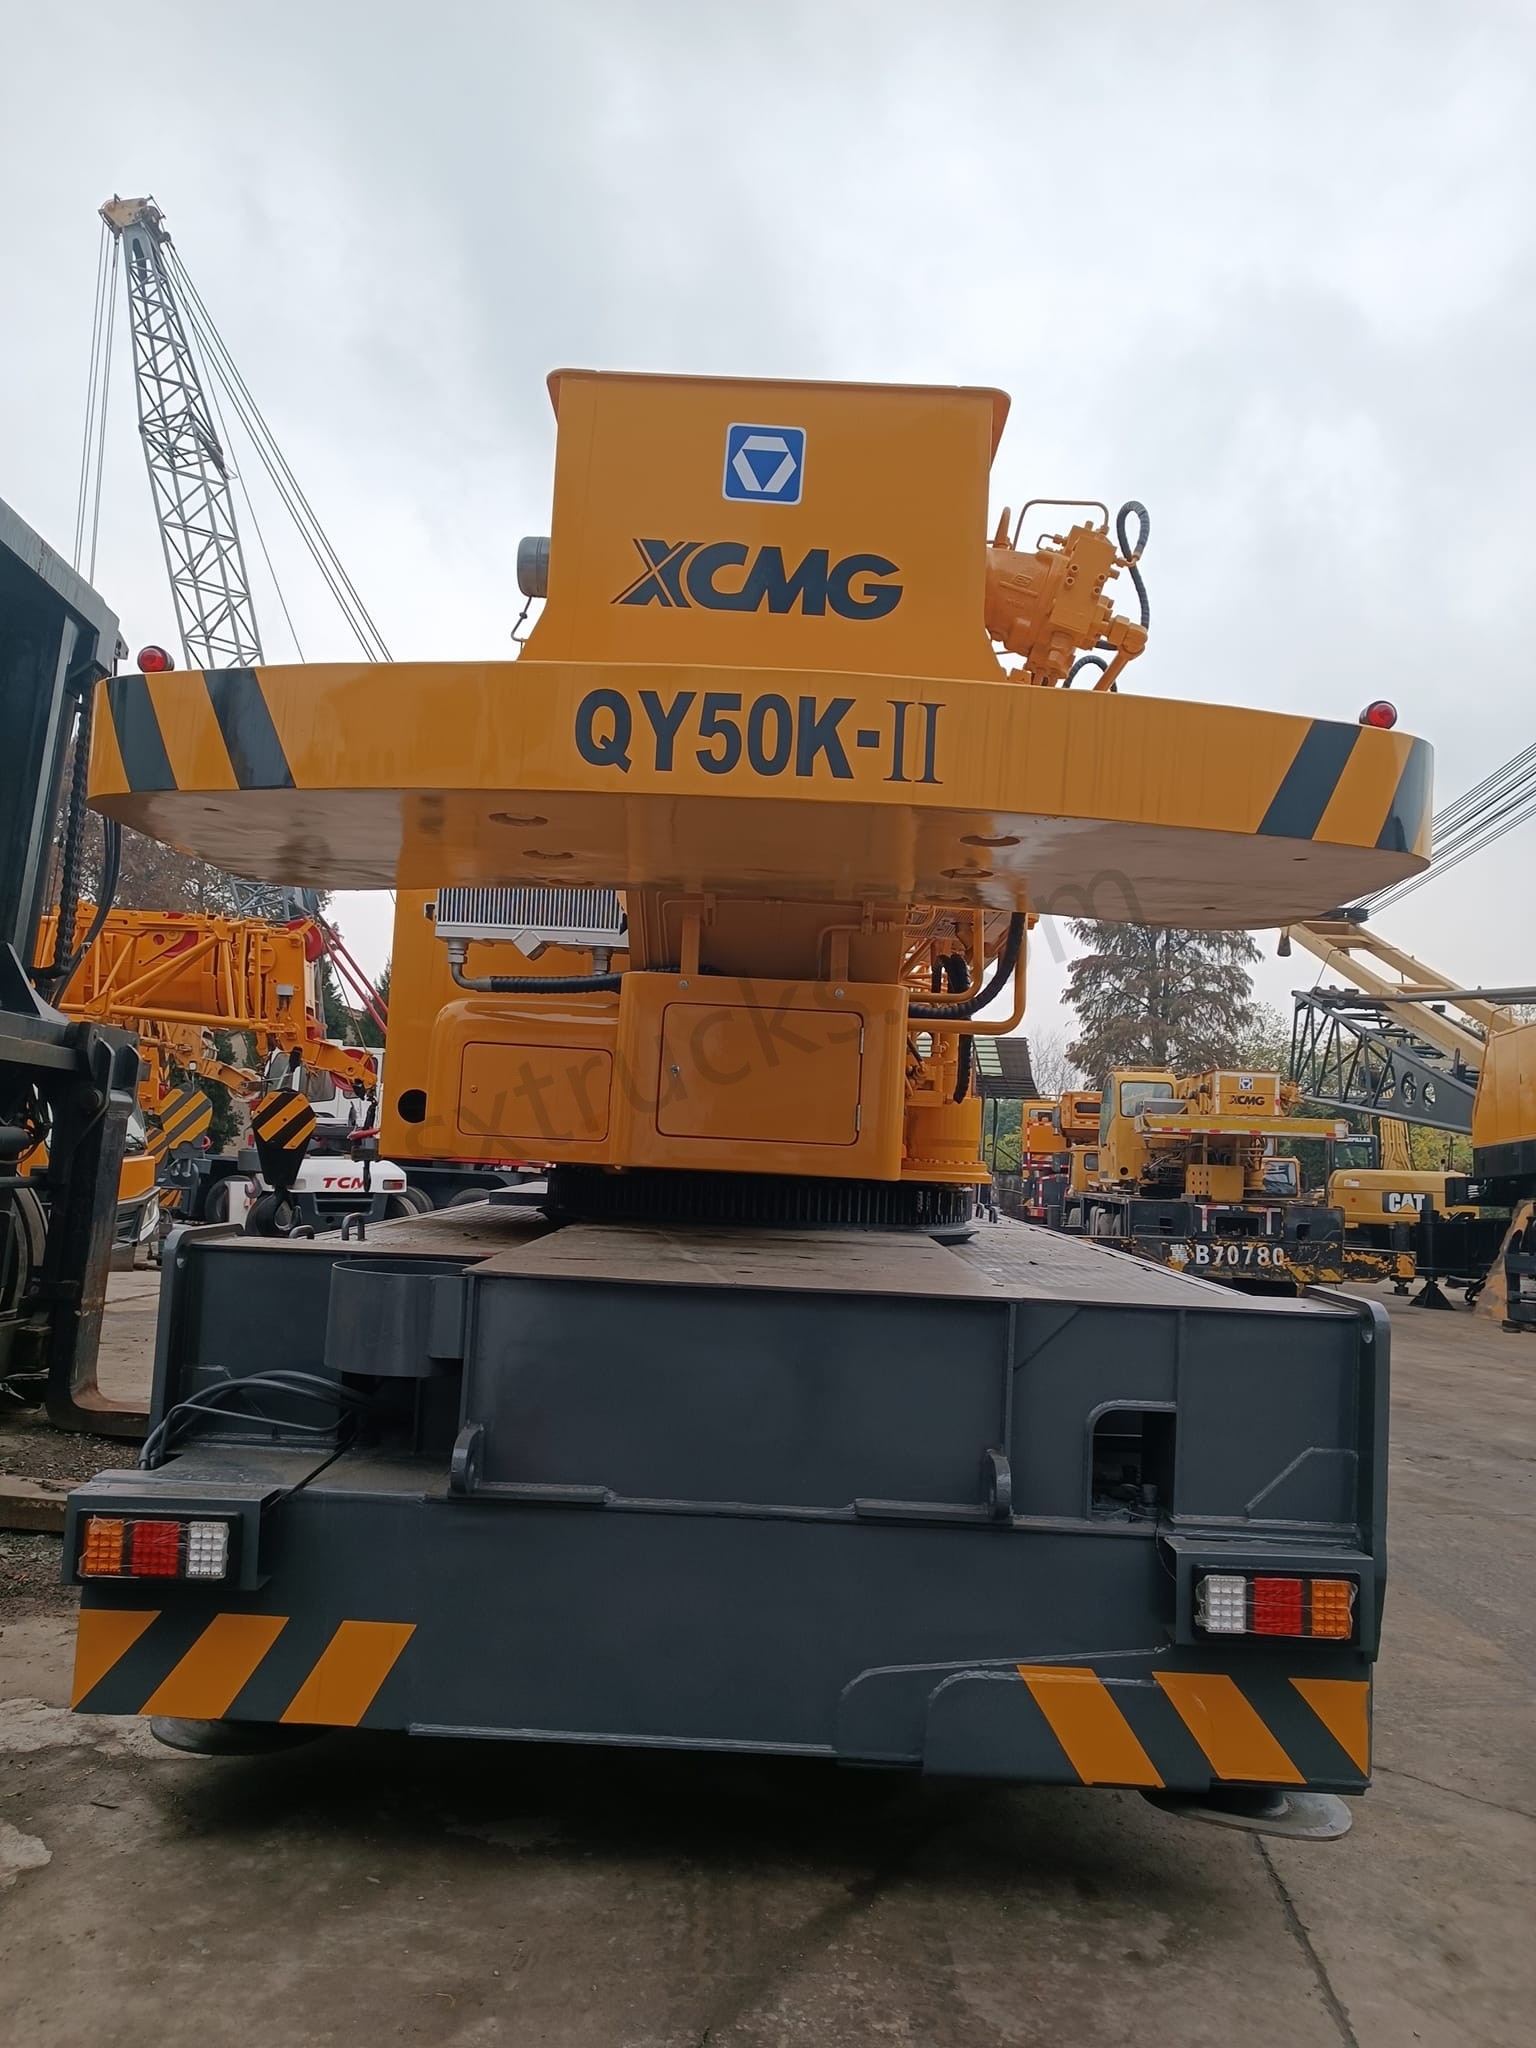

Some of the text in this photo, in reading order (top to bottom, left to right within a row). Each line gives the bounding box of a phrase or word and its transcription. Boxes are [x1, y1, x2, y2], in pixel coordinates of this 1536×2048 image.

[610, 538, 904, 620] XCMG
[574, 688, 946, 785] QY50K-II
[1227, 1094, 1265, 1106] XCMG
[323, 1177, 366, 1189] TCM
[1388, 1192, 1425, 1213] CAT
